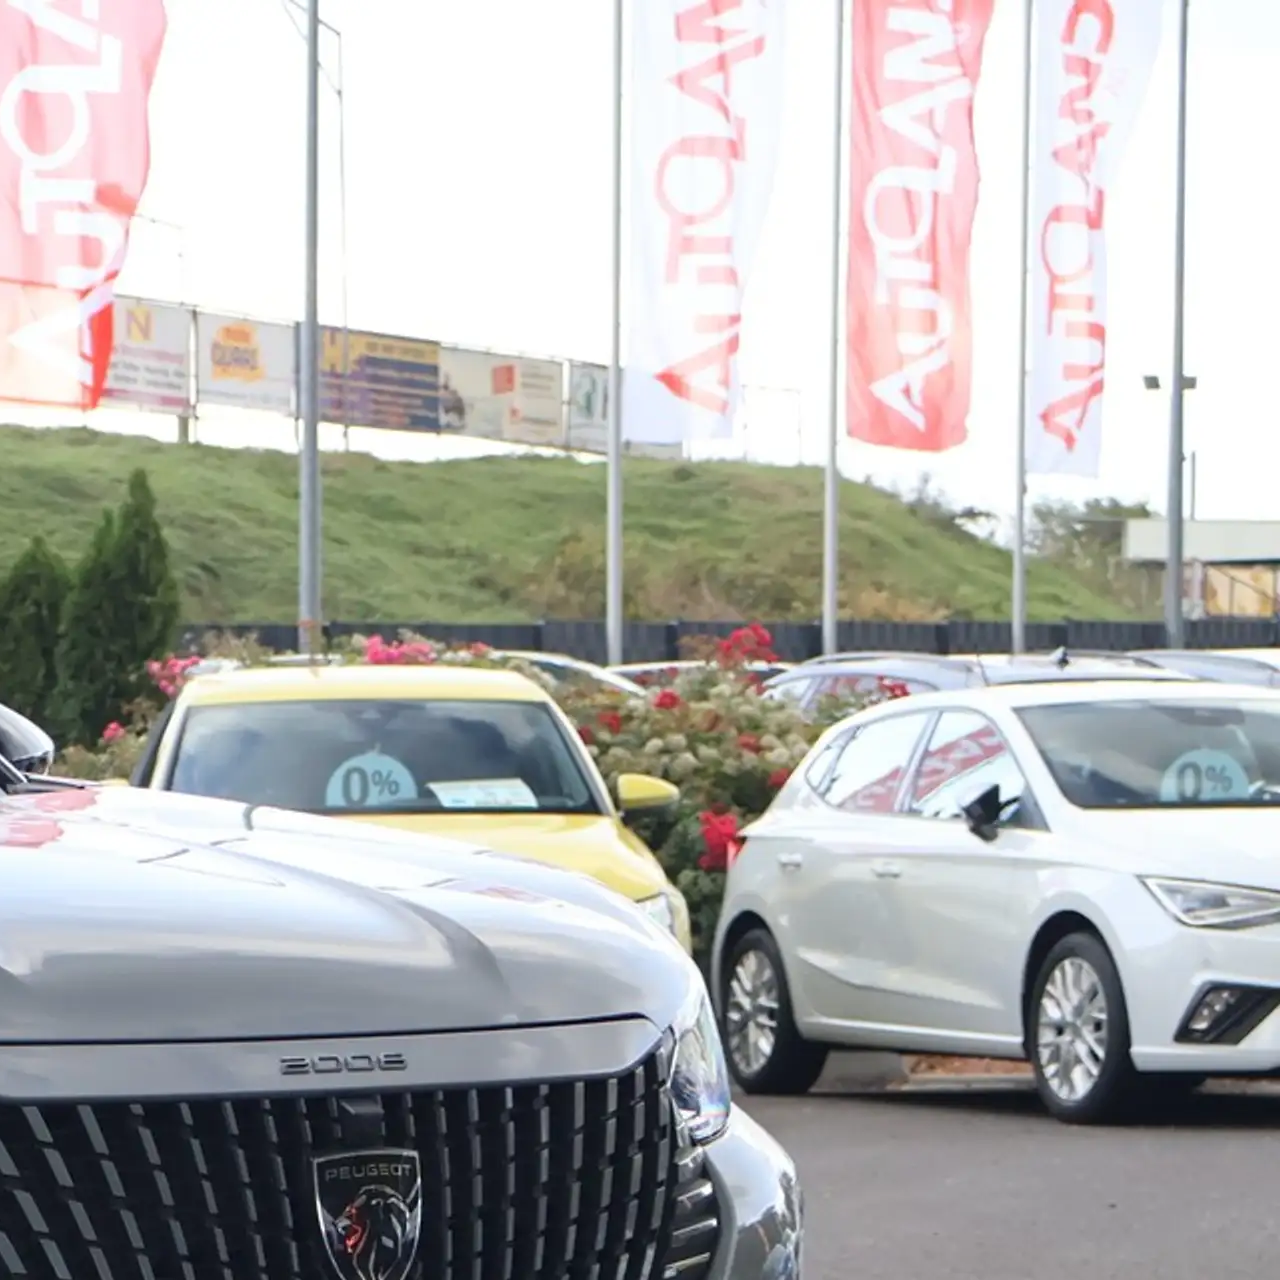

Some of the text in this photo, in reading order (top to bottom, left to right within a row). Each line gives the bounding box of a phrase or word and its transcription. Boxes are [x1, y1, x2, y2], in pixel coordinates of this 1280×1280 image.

[342, 766, 400, 805] 0%
[1176, 761, 1233, 801] 0%
[279, 1052, 408, 1075] 2008
[325, 1163, 413, 1182] PEUGEOT
